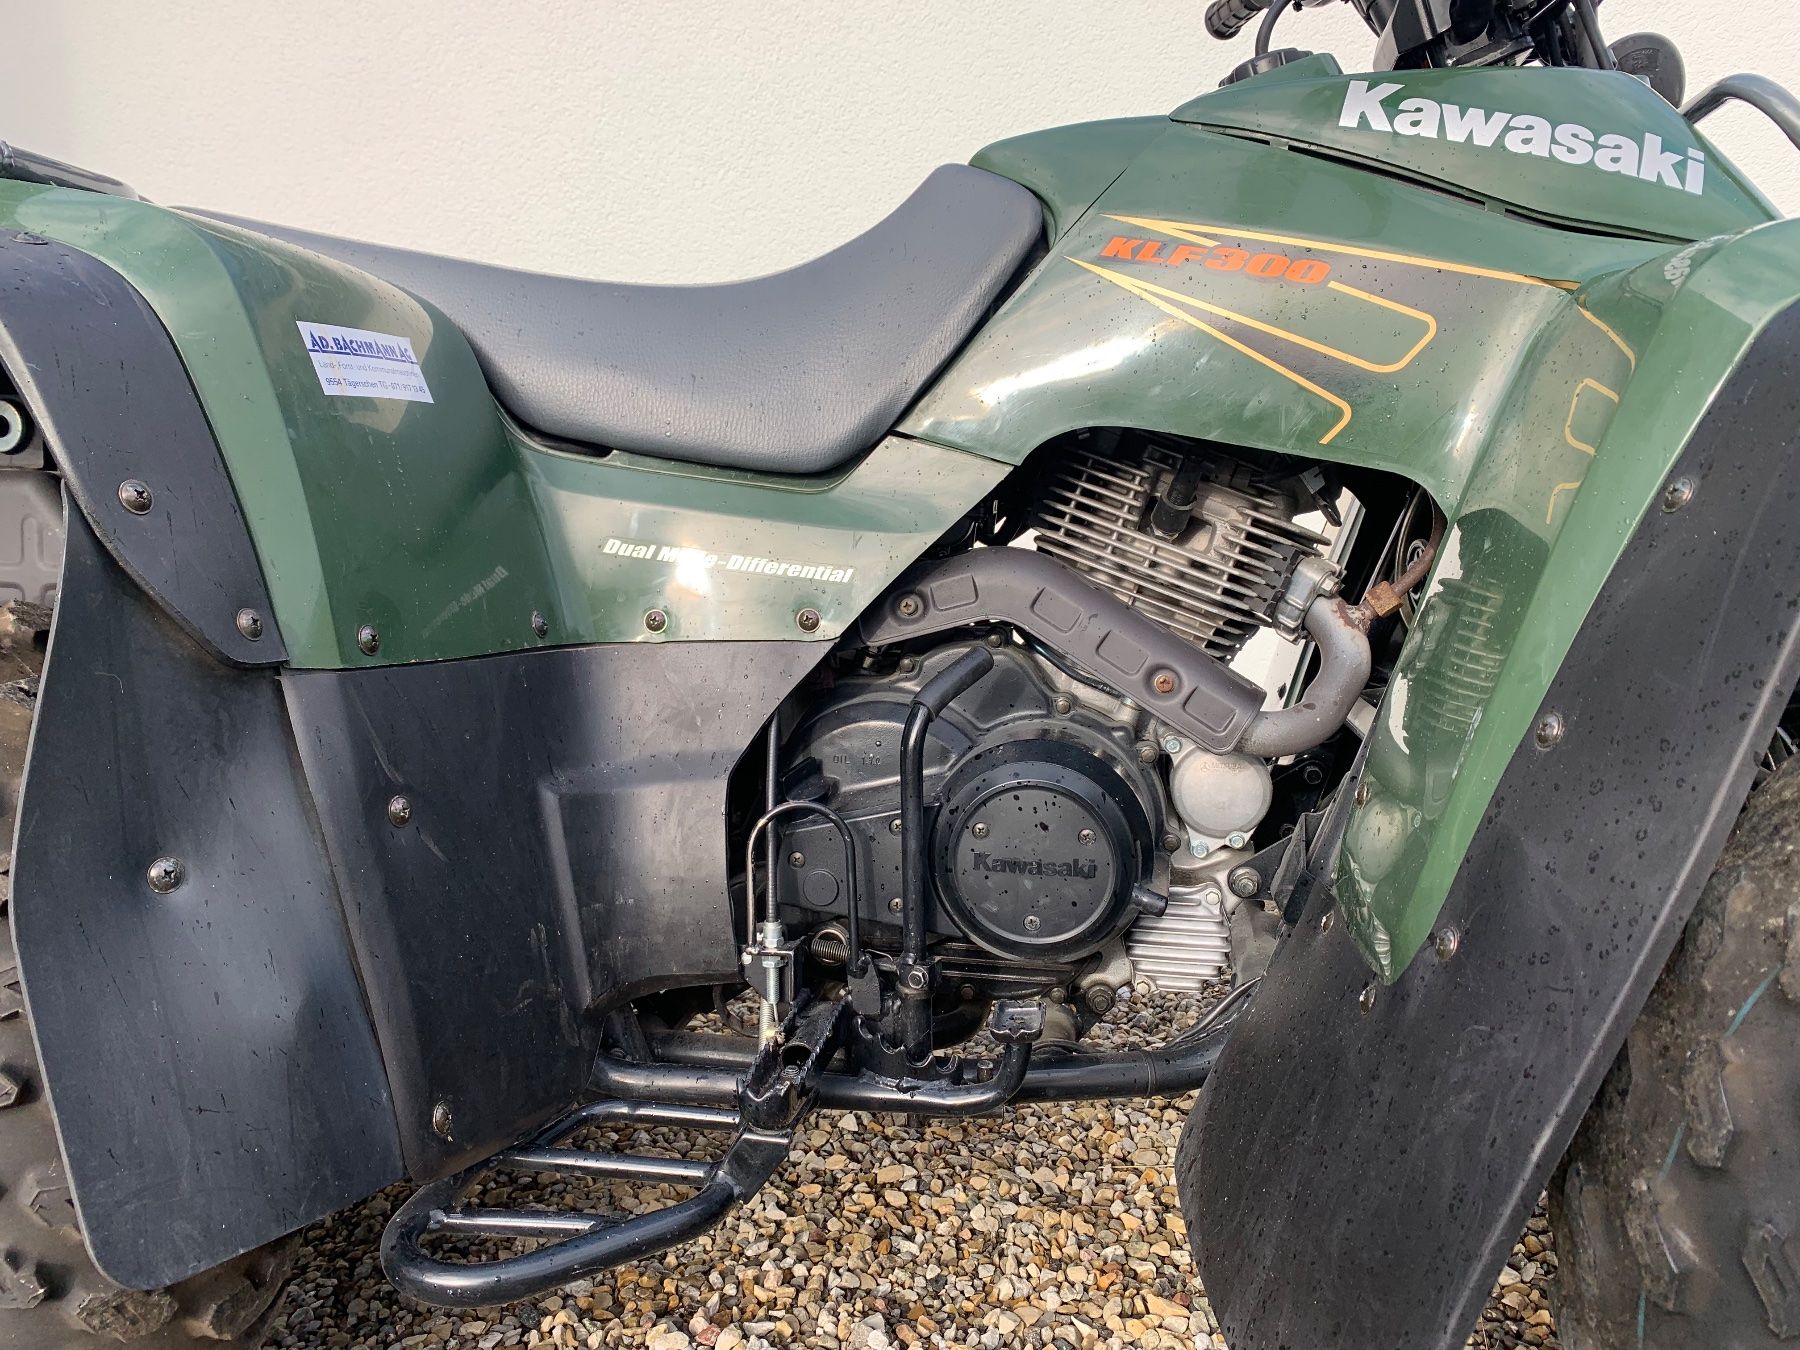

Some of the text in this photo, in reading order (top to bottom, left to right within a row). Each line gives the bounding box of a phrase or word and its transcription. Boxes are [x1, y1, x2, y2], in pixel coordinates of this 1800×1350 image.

[1338, 79, 1706, 196] Kawasaki
[1099, 235, 1332, 285] KLF300
[334, 334, 398, 359] BACHMANN
[325, 377, 343, 386] 9554
[602, 538, 855, 584] Dual Me-Differential
[832, 754, 851, 765] OIL
[973, 851, 1098, 879] Kawasaki
